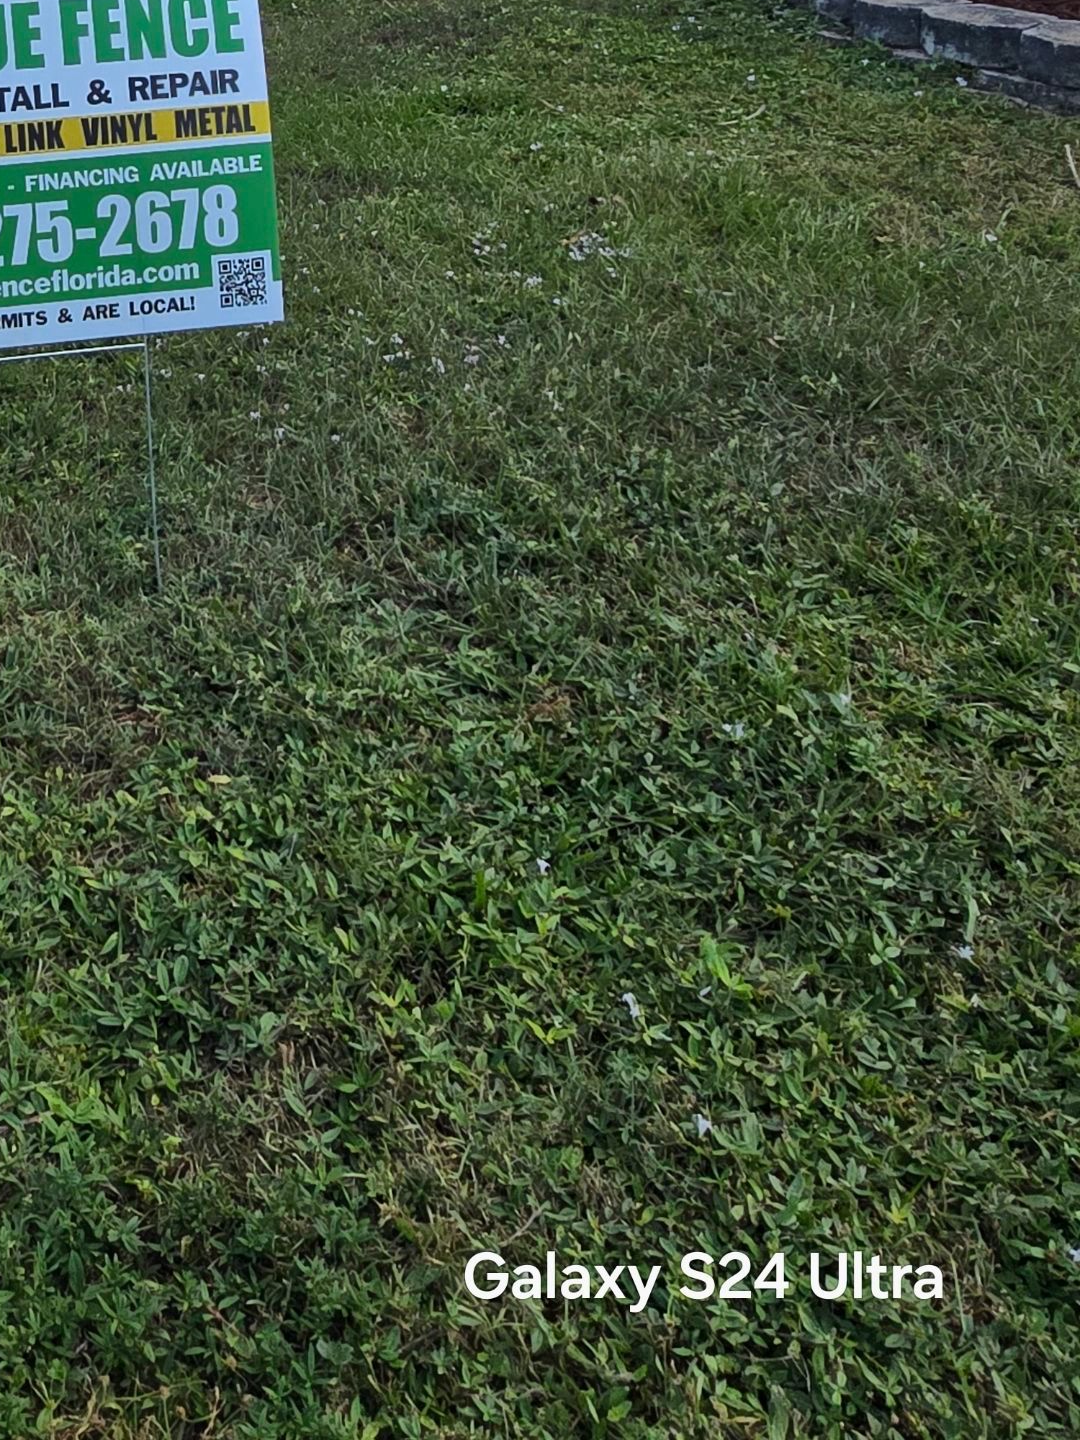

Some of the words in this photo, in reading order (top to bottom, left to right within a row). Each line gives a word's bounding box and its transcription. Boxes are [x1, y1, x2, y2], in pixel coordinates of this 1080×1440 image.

[86, 79, 112, 105] &
[127, 69, 240, 102] REPAIR
[5, 120, 66, 154] LINK
[80, 112, 157, 146] VINYL
[174, 104, 256, 138] METAL
[24, 166, 139, 193] FINANCING
[150, 154, 263, 182] AVAILABLE
[57, 308, 72, 323] &
[82, 303, 120, 321] ARE
[129, 296, 196, 316] LOCAL!
